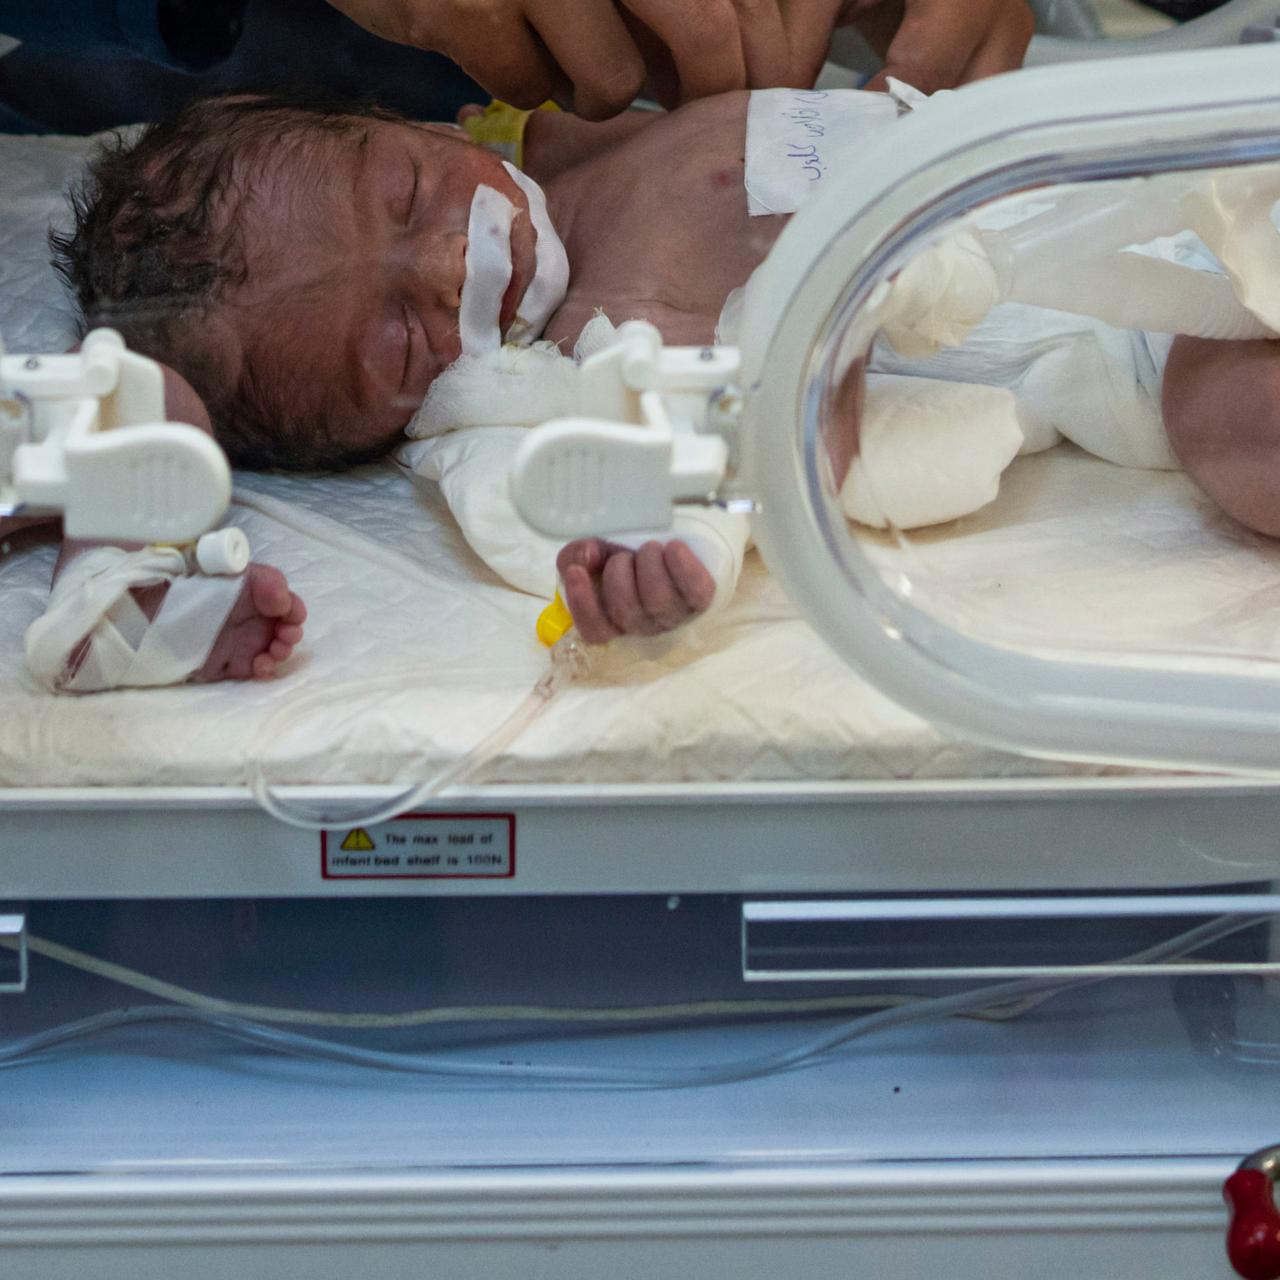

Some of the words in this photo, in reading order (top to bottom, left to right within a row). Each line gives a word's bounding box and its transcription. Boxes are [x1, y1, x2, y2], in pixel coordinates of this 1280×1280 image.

[385, 833, 407, 845] The
[413, 836, 439, 844] max
[448, 833, 473, 844] load
[480, 833, 494, 844] of
[332, 855, 371, 866] infant
[374, 855, 399, 866] bed
[406, 854, 441, 866] shelf
[447, 855, 459, 865] is
